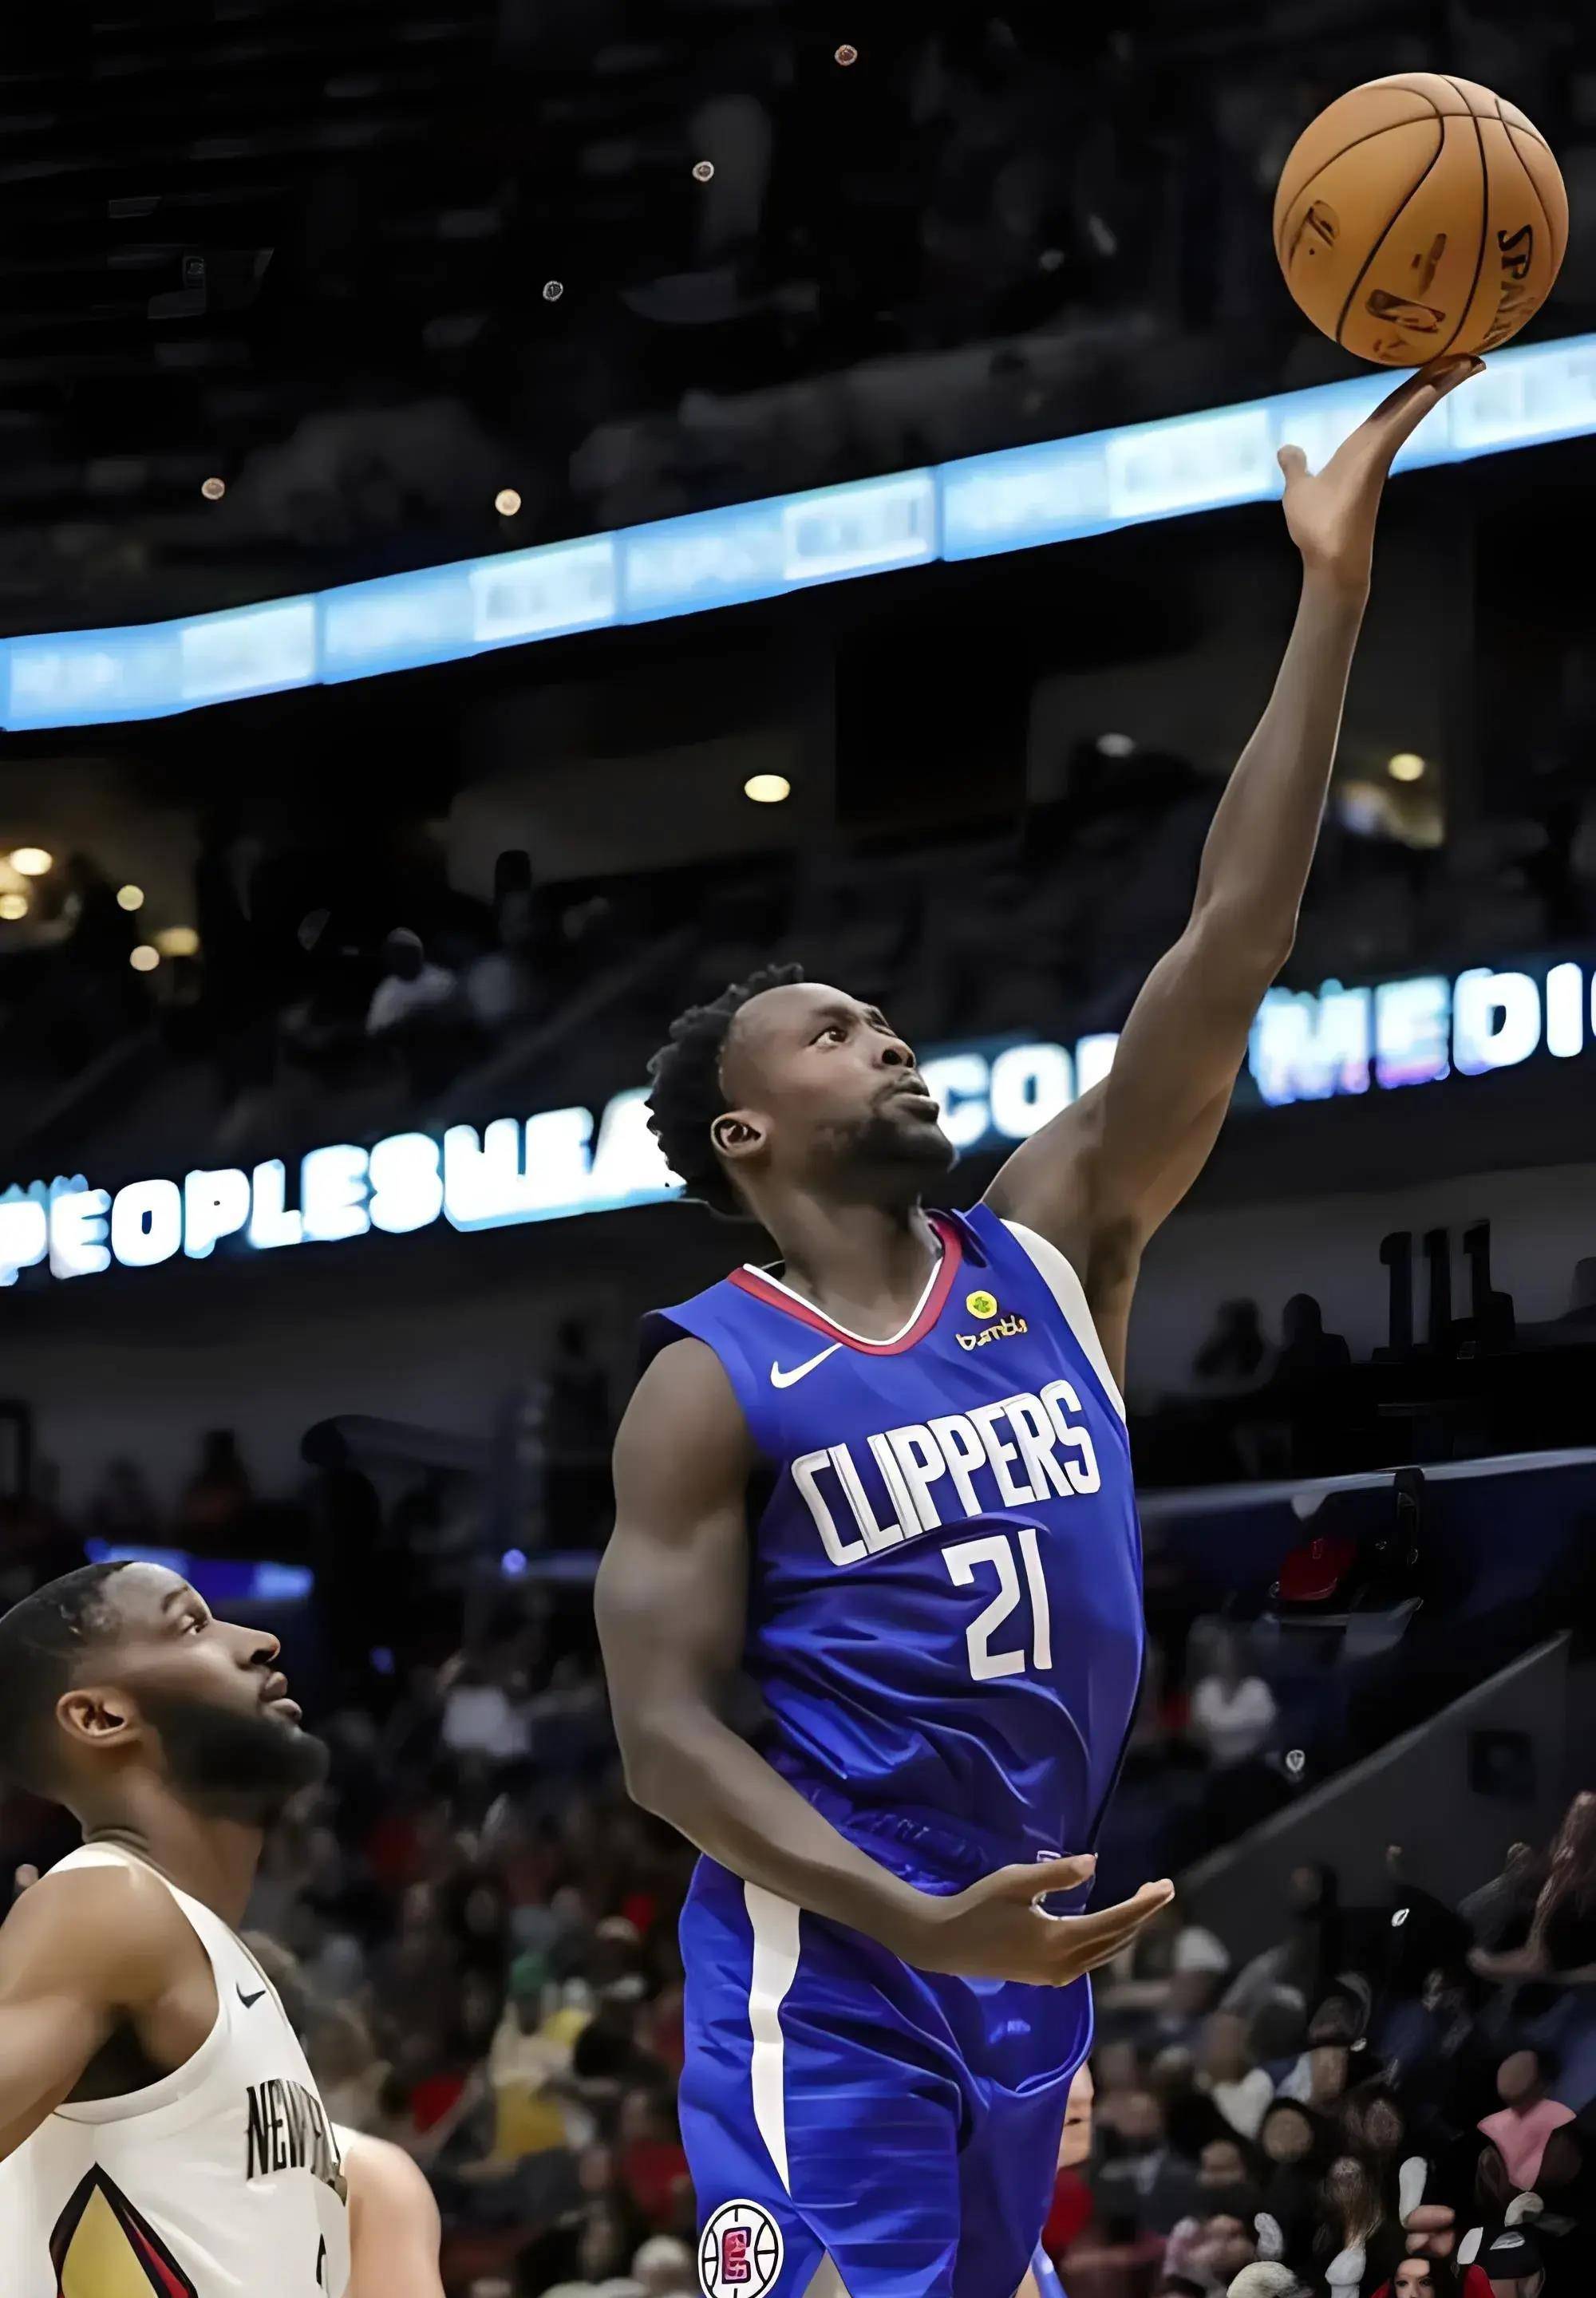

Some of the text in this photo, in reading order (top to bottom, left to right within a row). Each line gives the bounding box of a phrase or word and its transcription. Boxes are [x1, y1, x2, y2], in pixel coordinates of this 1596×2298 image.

[1249, 962, 1596, 1108] MEDI
[791, 1379, 1101, 1566] CLIPPERS
[942, 1529, 1053, 1681] 21
